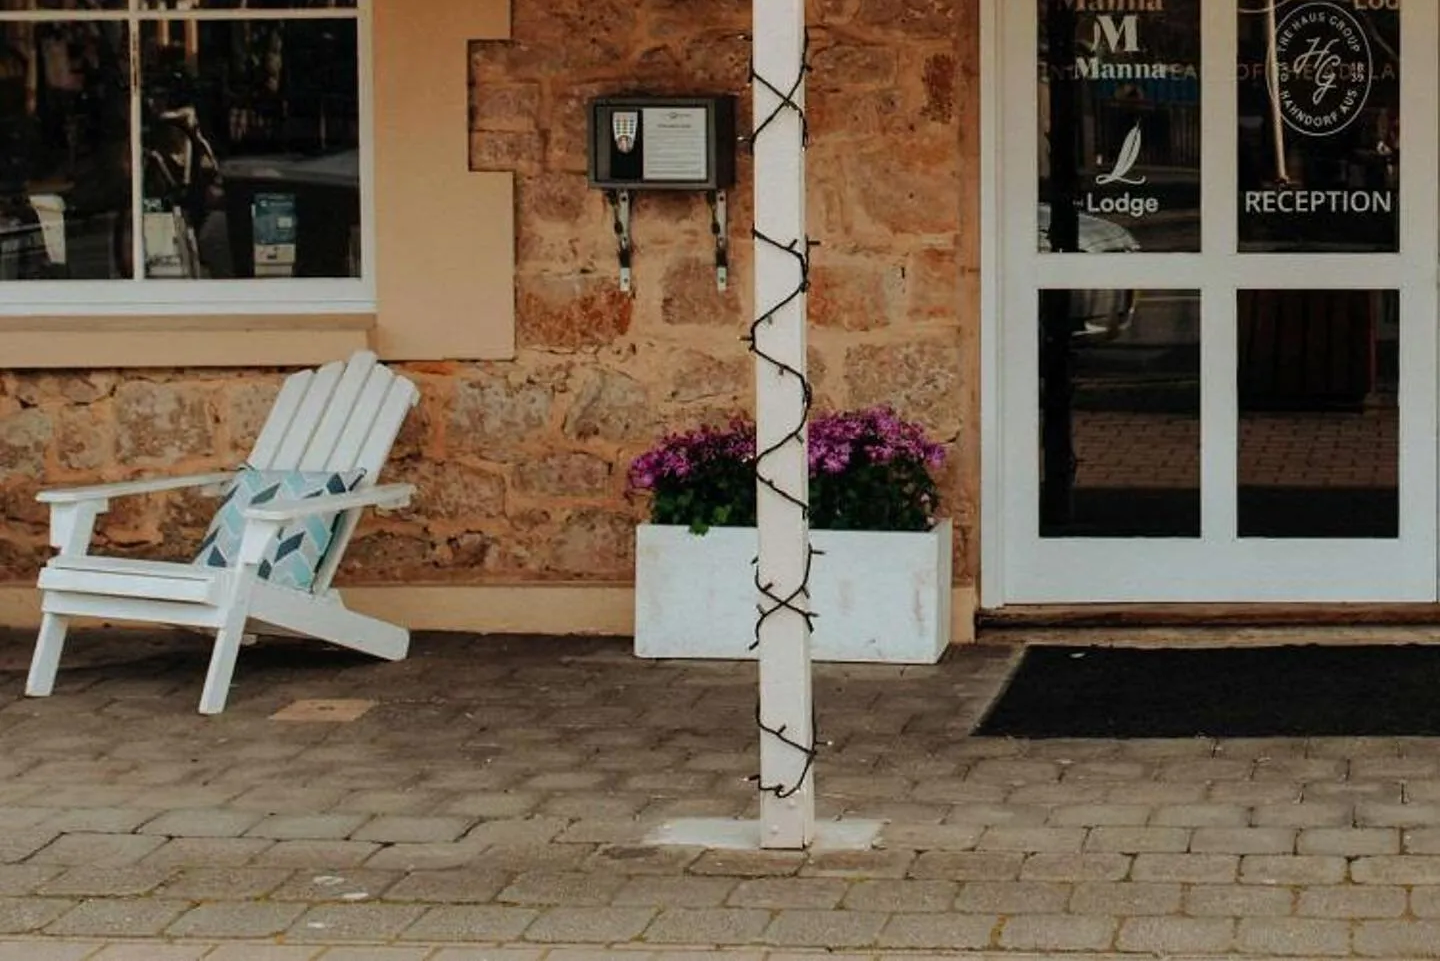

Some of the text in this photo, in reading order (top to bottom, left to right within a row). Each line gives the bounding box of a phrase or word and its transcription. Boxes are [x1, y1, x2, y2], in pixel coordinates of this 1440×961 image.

[1292, 12, 1326, 31] HAUS
[1329, 15, 1361, 52] GROUP
[1074, 56, 1167, 80] Manna
[1280, 90, 1338, 127] HAHNDORF
[1087, 191, 1159, 217] Lodge
[1245, 190, 1391, 212] RECEPTION
